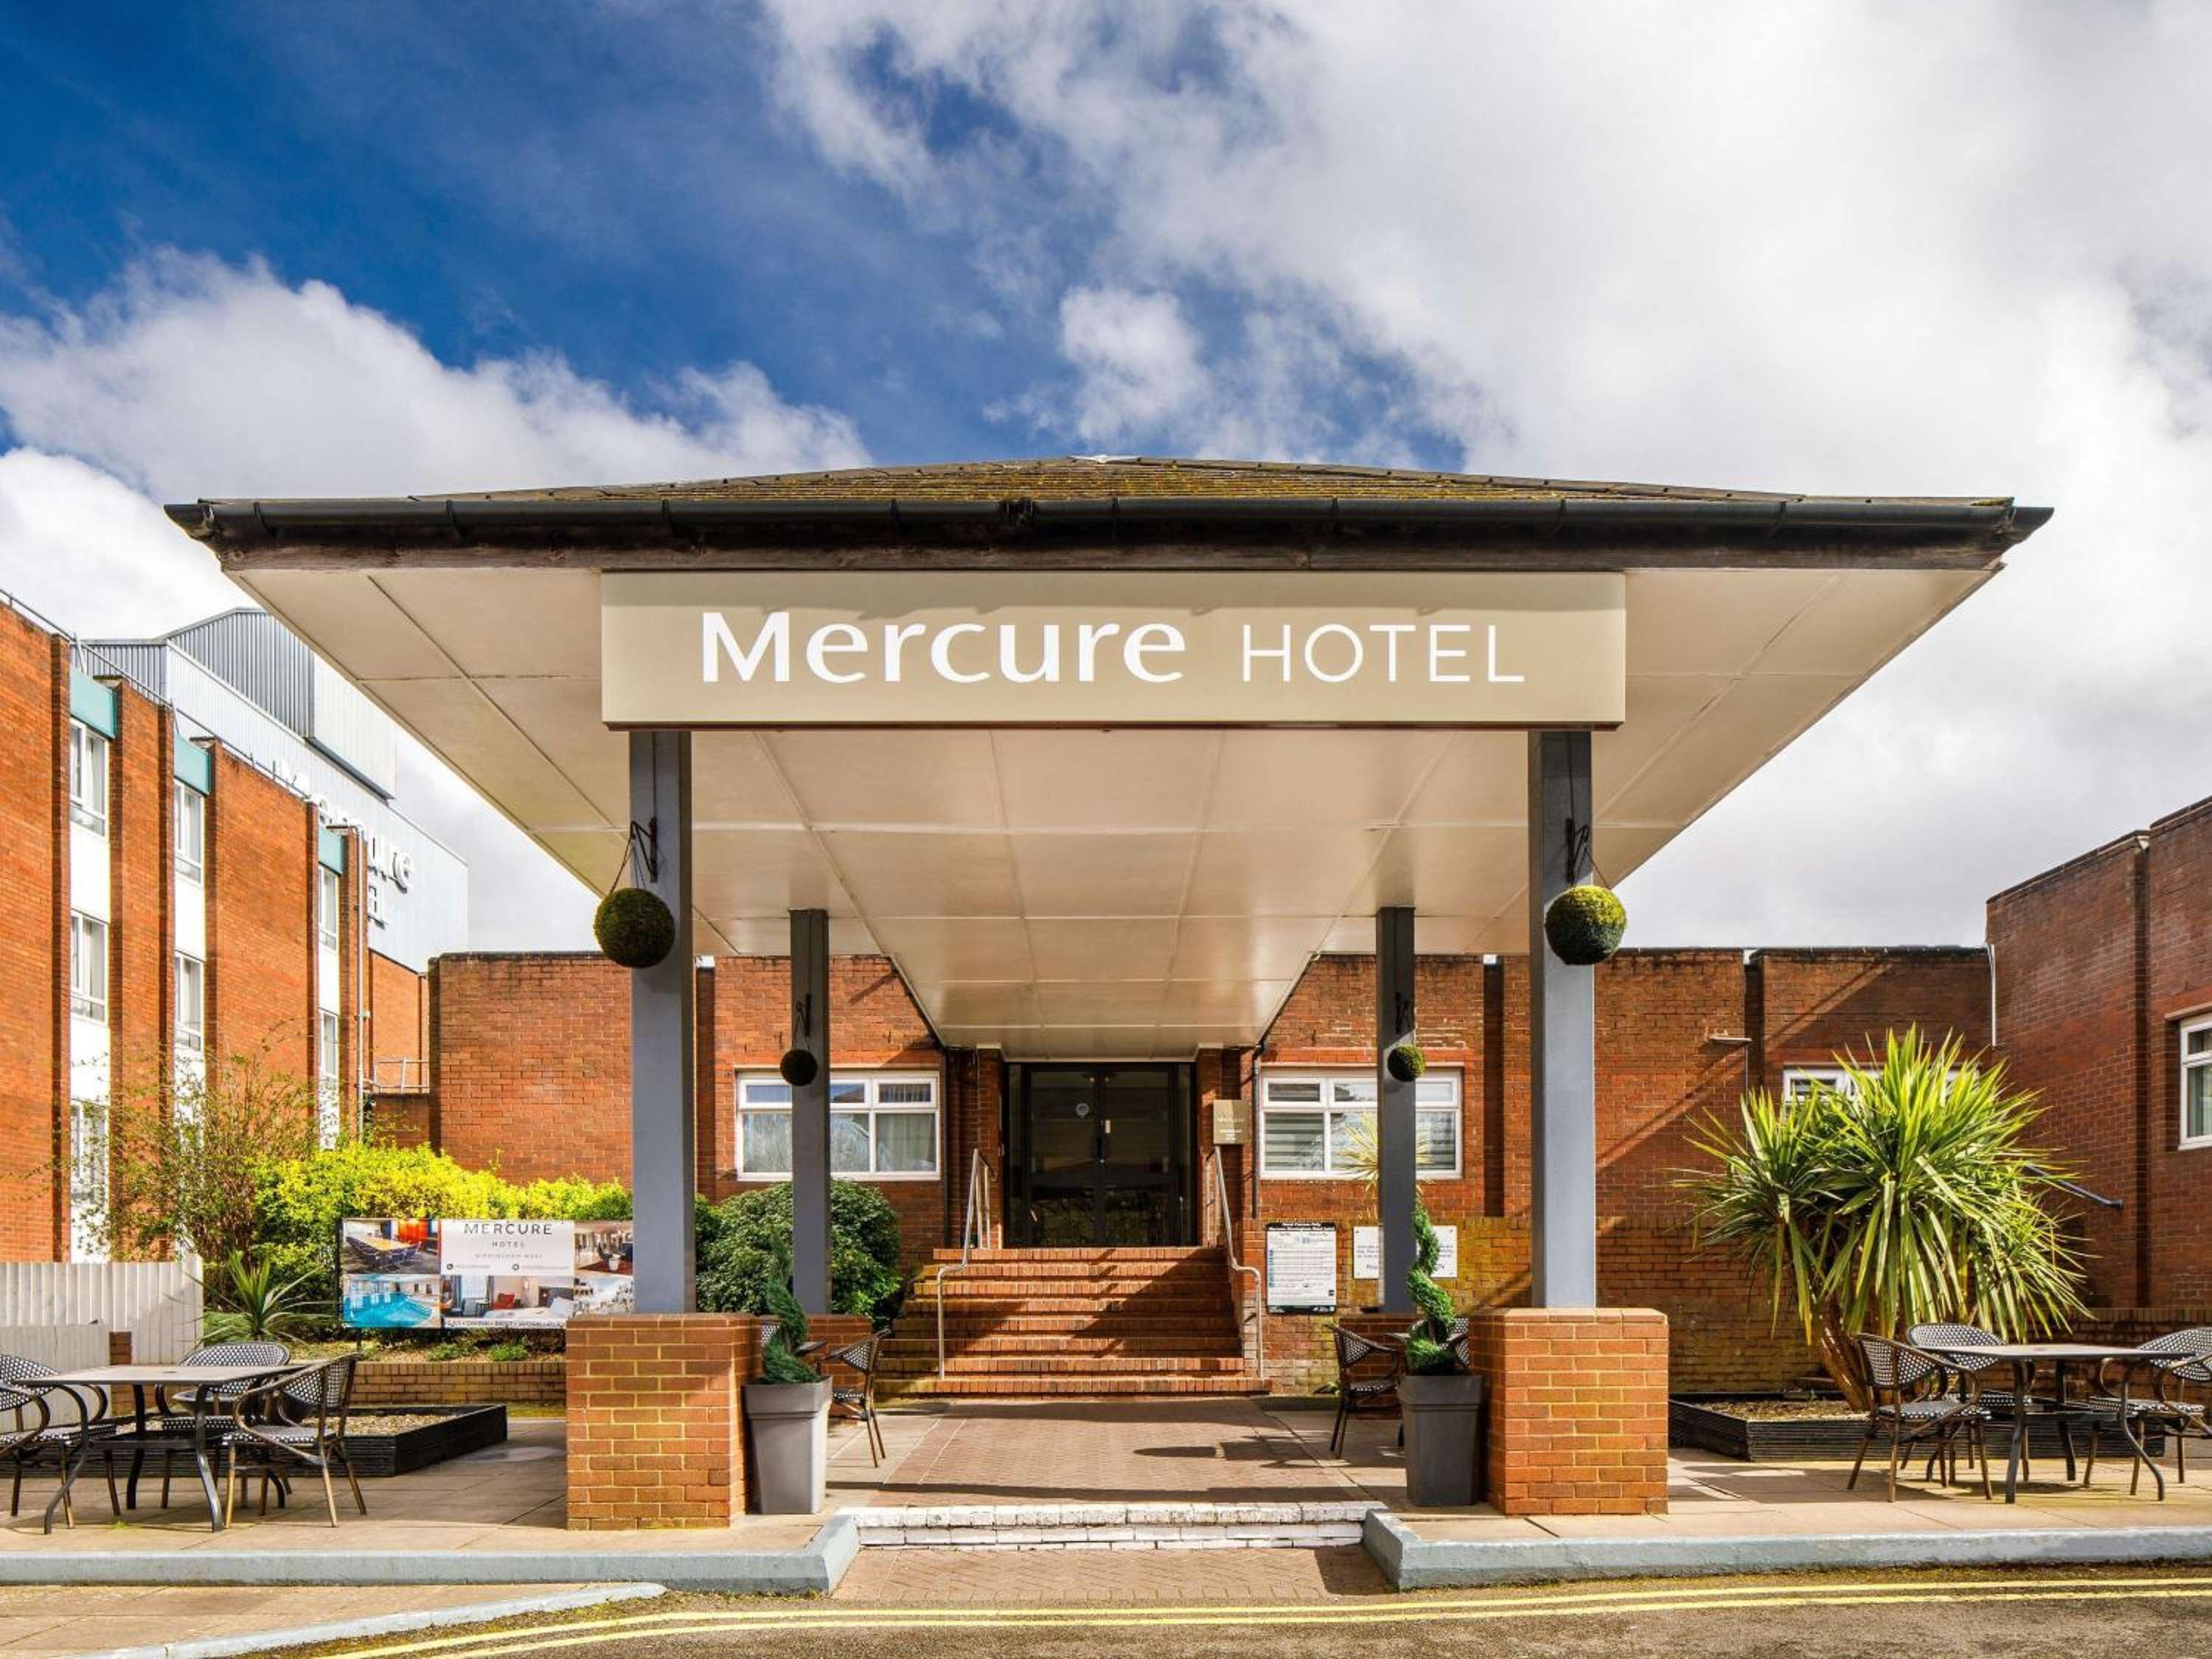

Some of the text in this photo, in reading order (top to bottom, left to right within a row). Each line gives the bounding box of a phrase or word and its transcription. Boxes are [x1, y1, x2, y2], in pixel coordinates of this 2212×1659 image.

[702, 612, 1524, 683] Mercure HOTEL
[463, 1222, 553, 1235] MERCURE
